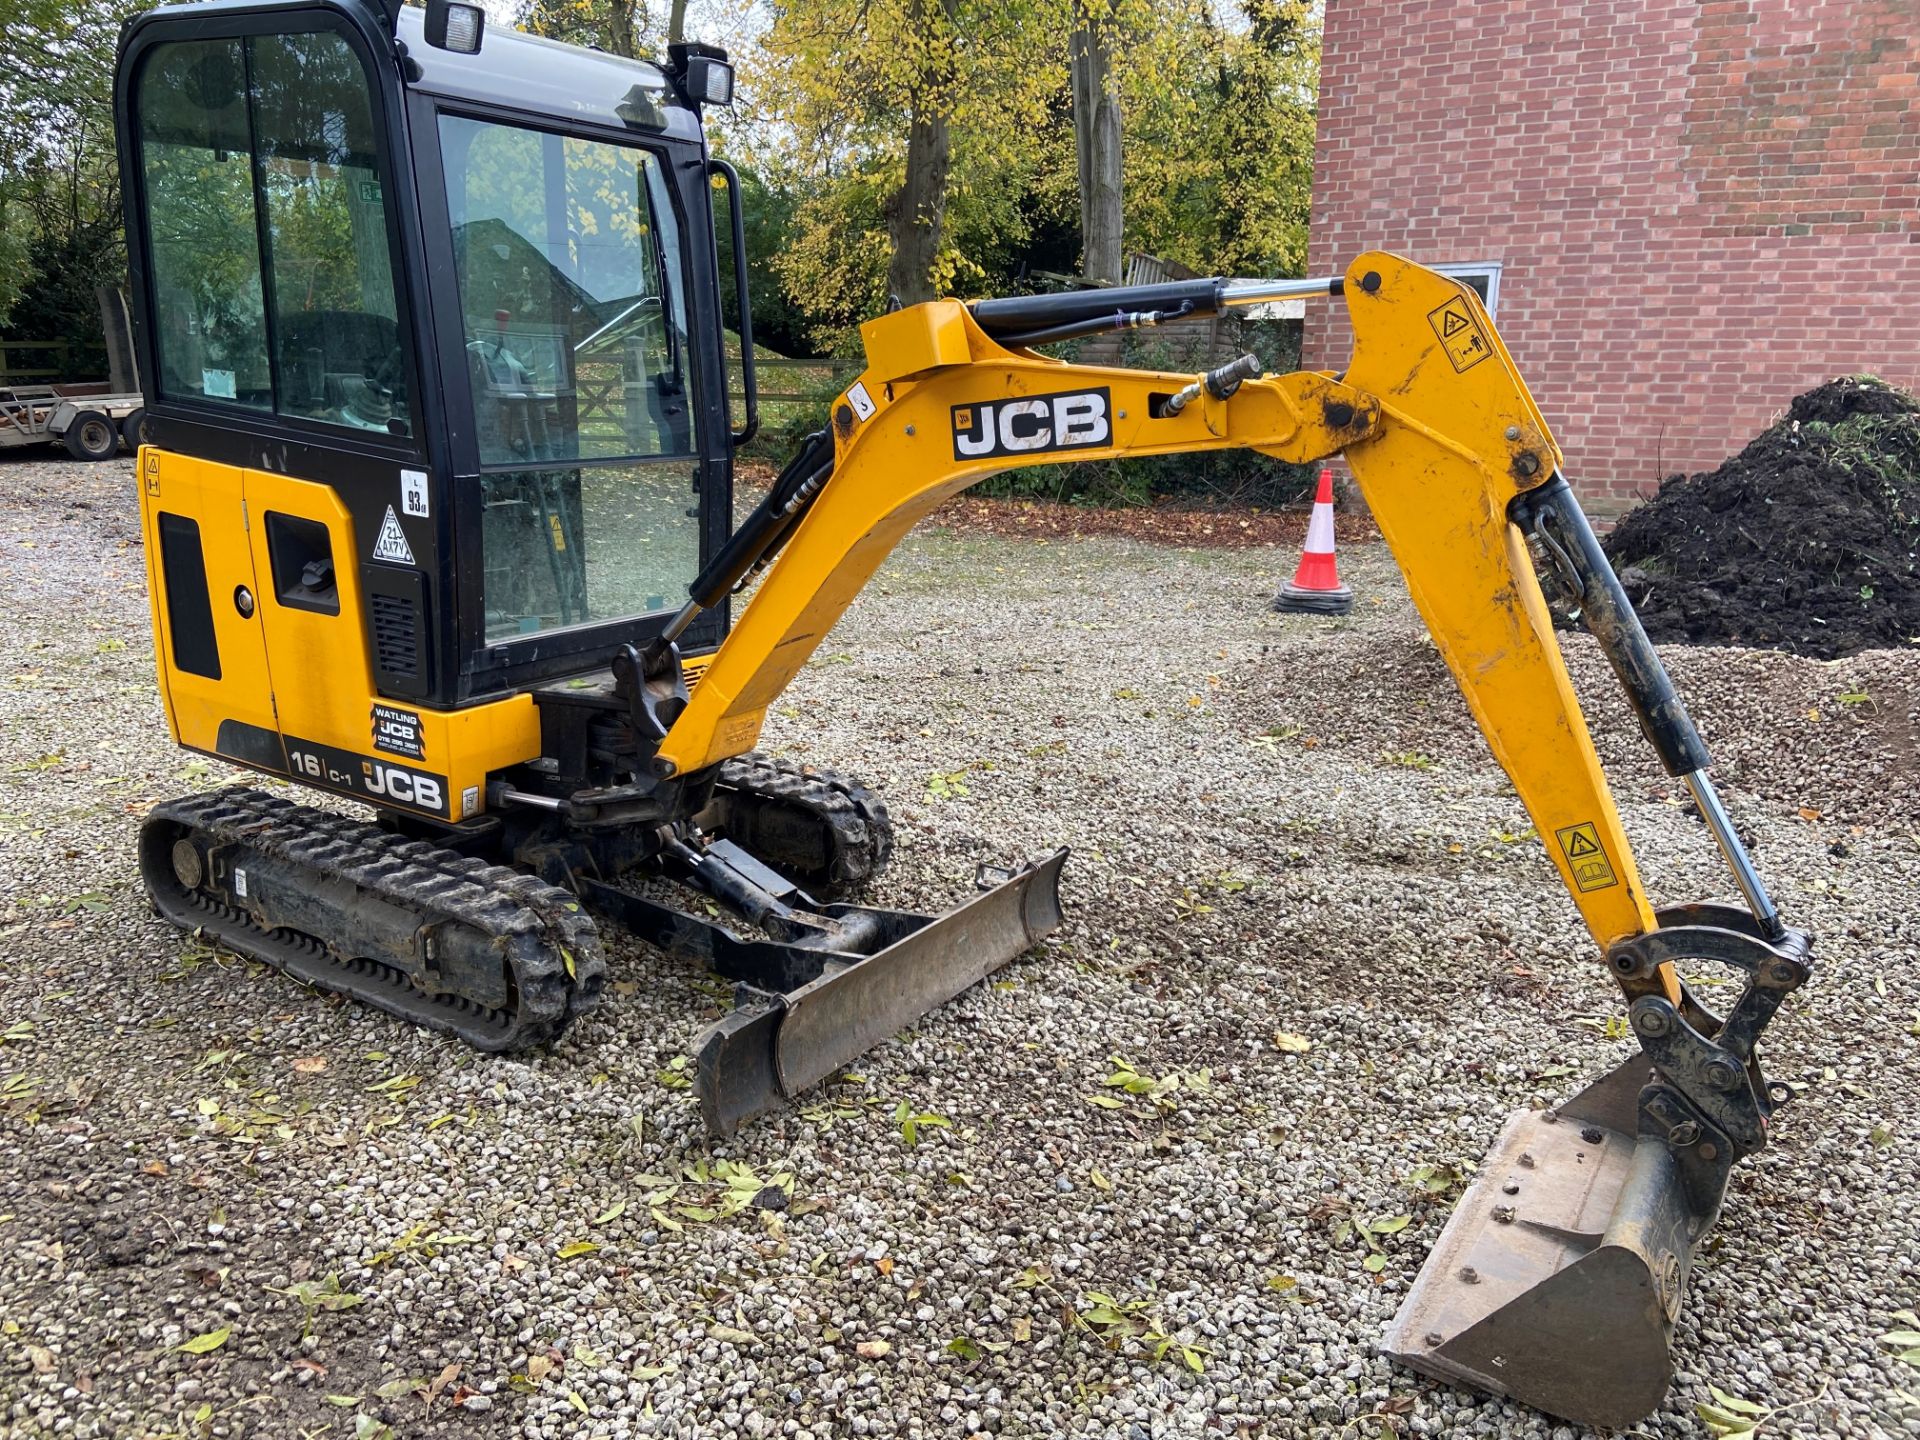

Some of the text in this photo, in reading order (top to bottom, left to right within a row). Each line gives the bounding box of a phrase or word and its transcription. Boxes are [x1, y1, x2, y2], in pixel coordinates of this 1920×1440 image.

[956, 393, 1109, 455] JCB
[408, 490, 421, 513] 93
[386, 526, 398, 540] 21
[375, 707, 417, 725] WATLING
[380, 722, 414, 740] JCB
[291, 751, 321, 777] 16
[364, 765, 443, 810] JCB
